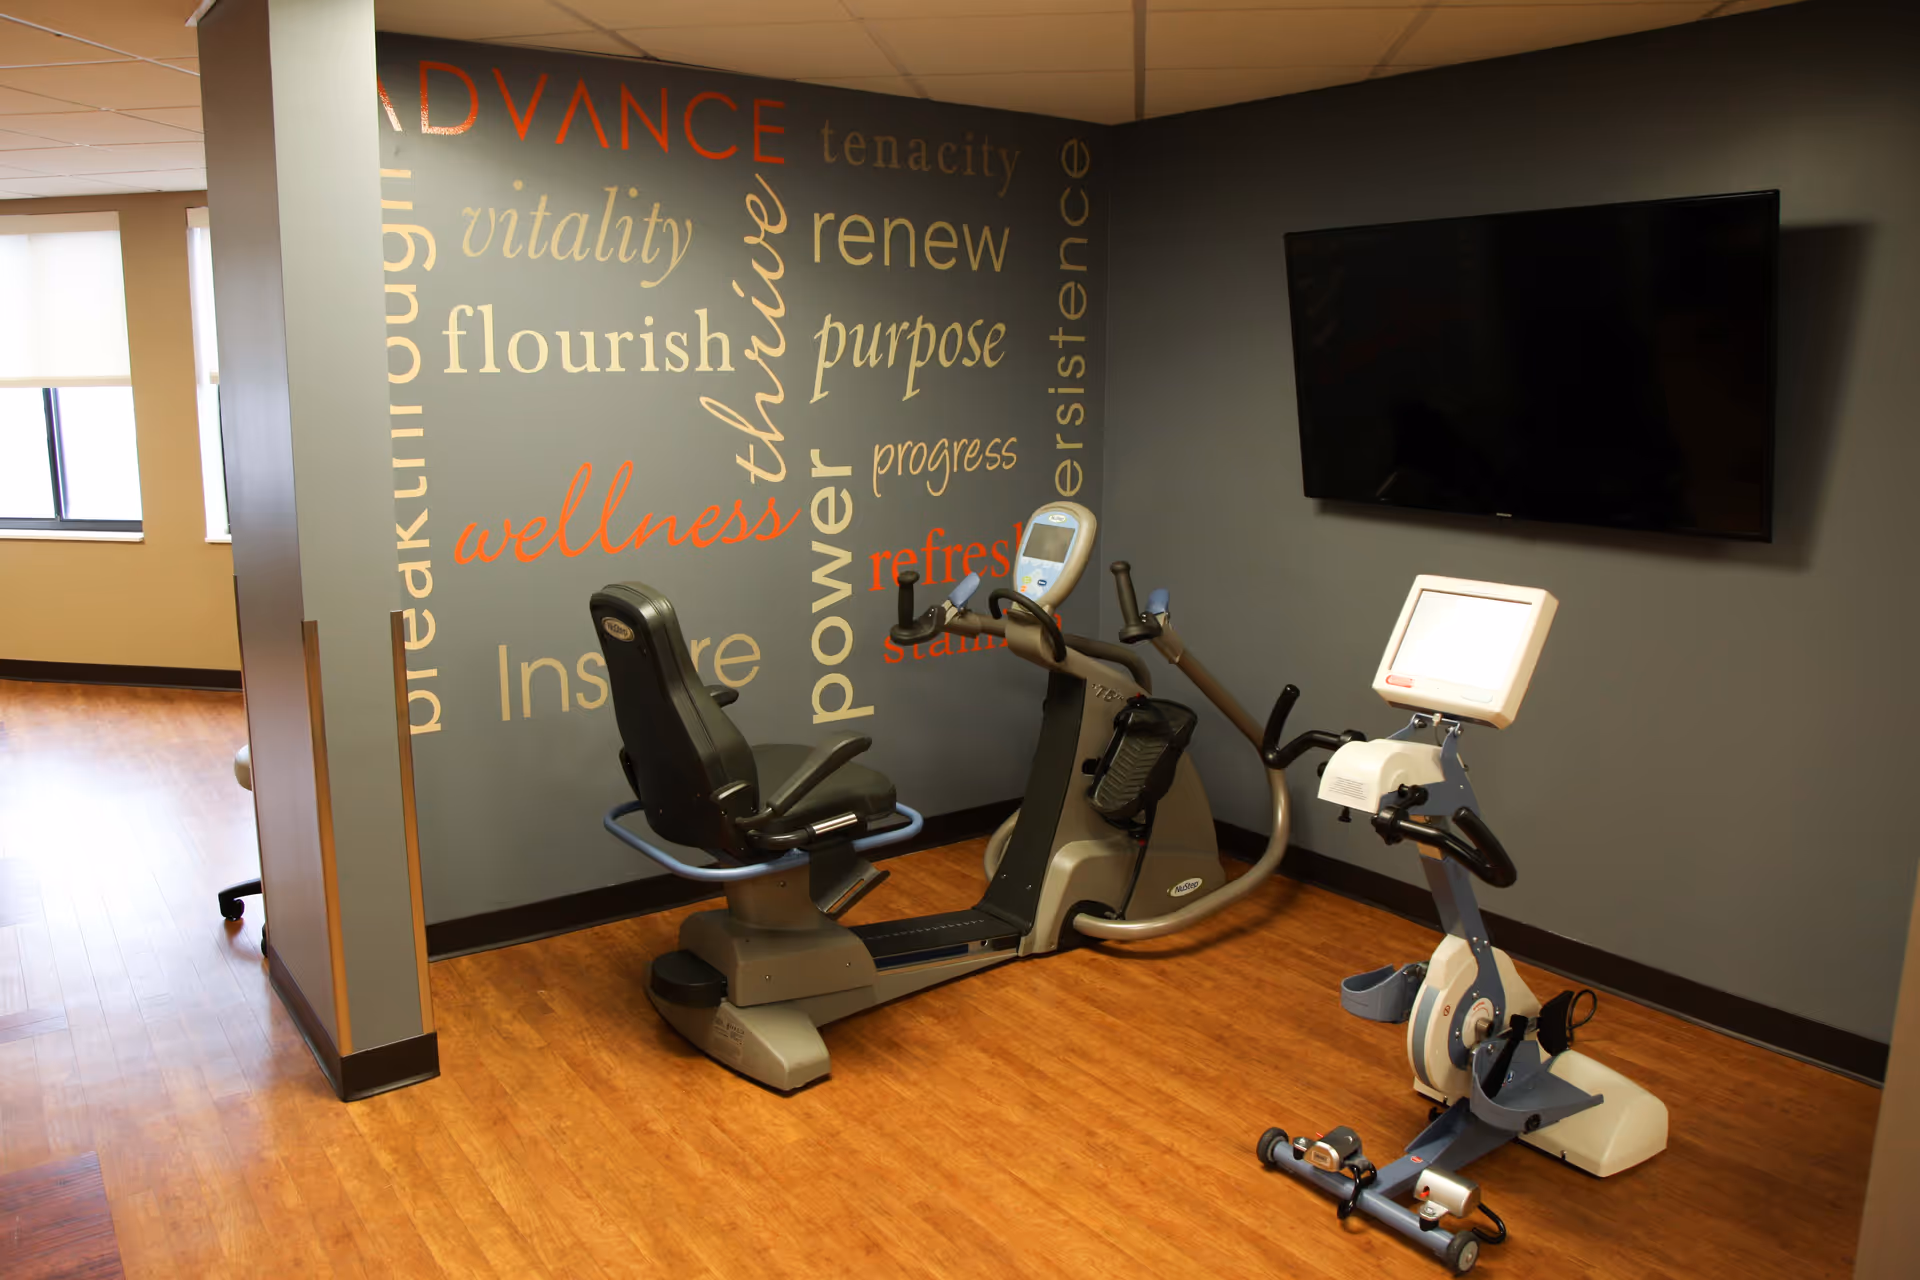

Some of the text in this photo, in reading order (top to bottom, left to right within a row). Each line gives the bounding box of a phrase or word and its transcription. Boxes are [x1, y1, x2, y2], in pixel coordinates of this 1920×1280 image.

[820, 118, 1021, 198] tenacity
[461, 179, 692, 288] vitality
[813, 211, 1010, 273] renew
[442, 303, 735, 374] flourish
[699, 172, 788, 485] thrive
[808, 312, 1007, 404] purpose
[1048, 137, 1091, 497] ersistence
[454, 460, 801, 565] wellness
[872, 436, 1018, 498] progress
[810, 448, 875, 725] power
[498, 632, 761, 722] Insre
[1175, 880, 1199, 895] NuStep
